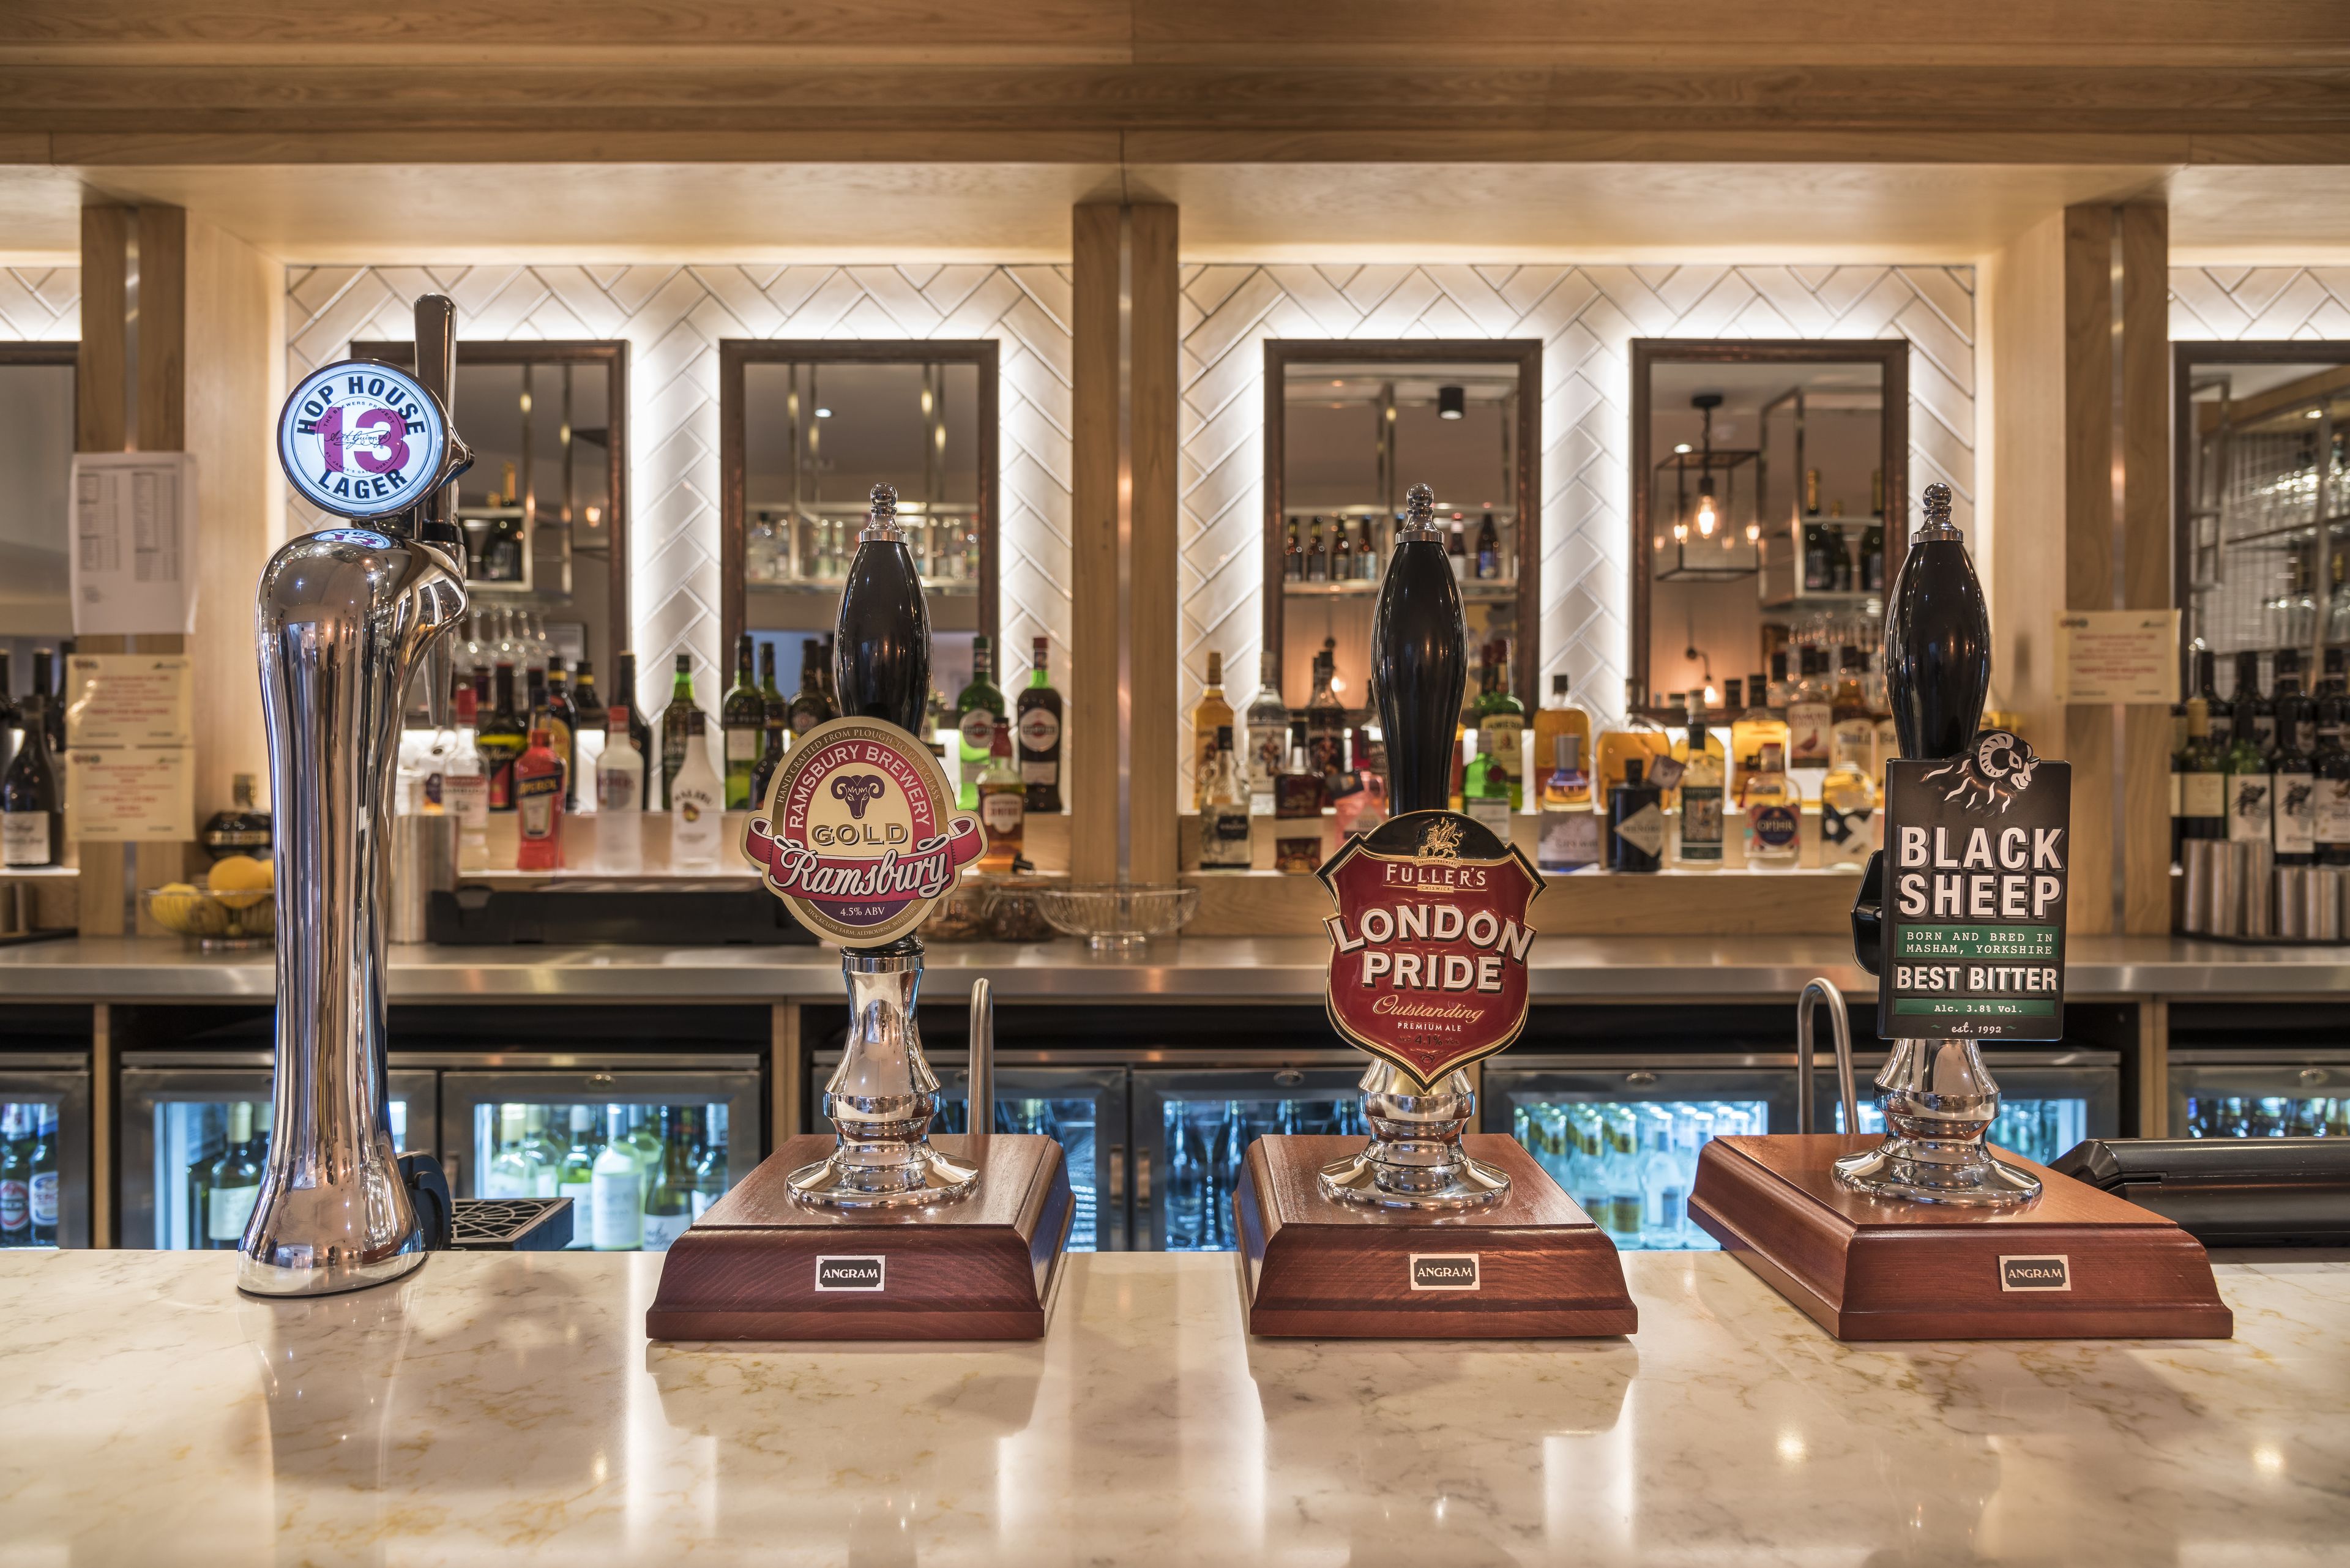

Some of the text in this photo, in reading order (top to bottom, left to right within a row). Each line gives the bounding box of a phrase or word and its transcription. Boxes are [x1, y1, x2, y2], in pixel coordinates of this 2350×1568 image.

[296, 376, 427, 436] HOP HOUSE
[324, 401, 395, 427] THE BREWERS PROJECT
[308, 406, 410, 474] 13
[376, 457, 392, 470] DUBLIN
[318, 468, 408, 499] LAGER
[777, 729, 941, 803] HAND CRAFTED FROM PLOUGH TO PINT GLASS
[789, 745, 930, 828] RAMSBURY BREWERY
[811, 823, 909, 845] GOLD
[1900, 827, 2064, 870] BLACK
[769, 848, 950, 898] Ramsbury
[1386, 864, 1486, 887] FULLER'S
[1899, 873, 2062, 917] SHEEP
[807, 908, 838, 930] STOCKCLOSE
[892, 905, 918, 927] WILTSHIRE
[840, 906, 886, 916] 4.5% ABV
[1329, 904, 1535, 963] LONDON
[1907, 932, 2053, 943] BORN AND BRED IN
[1906, 944, 2052, 955] MASHAM, YORKSHIRE
[1362, 951, 1504, 992] PRIDE
[1897, 966, 2058, 991] BEST BITTER
[1373, 995, 1485, 1023] Outstanding
[1398, 1022, 1442, 1031] PREMIUM
[1951, 1023, 2002, 1034] est. 1992
[1414, 1035, 1442, 1046] 4.1%
[822, 1269, 878, 1278] ANGRAM
[1417, 1267, 1472, 1277] ANGRAM
[2008, 1268, 2063, 1279] ANGRAM
